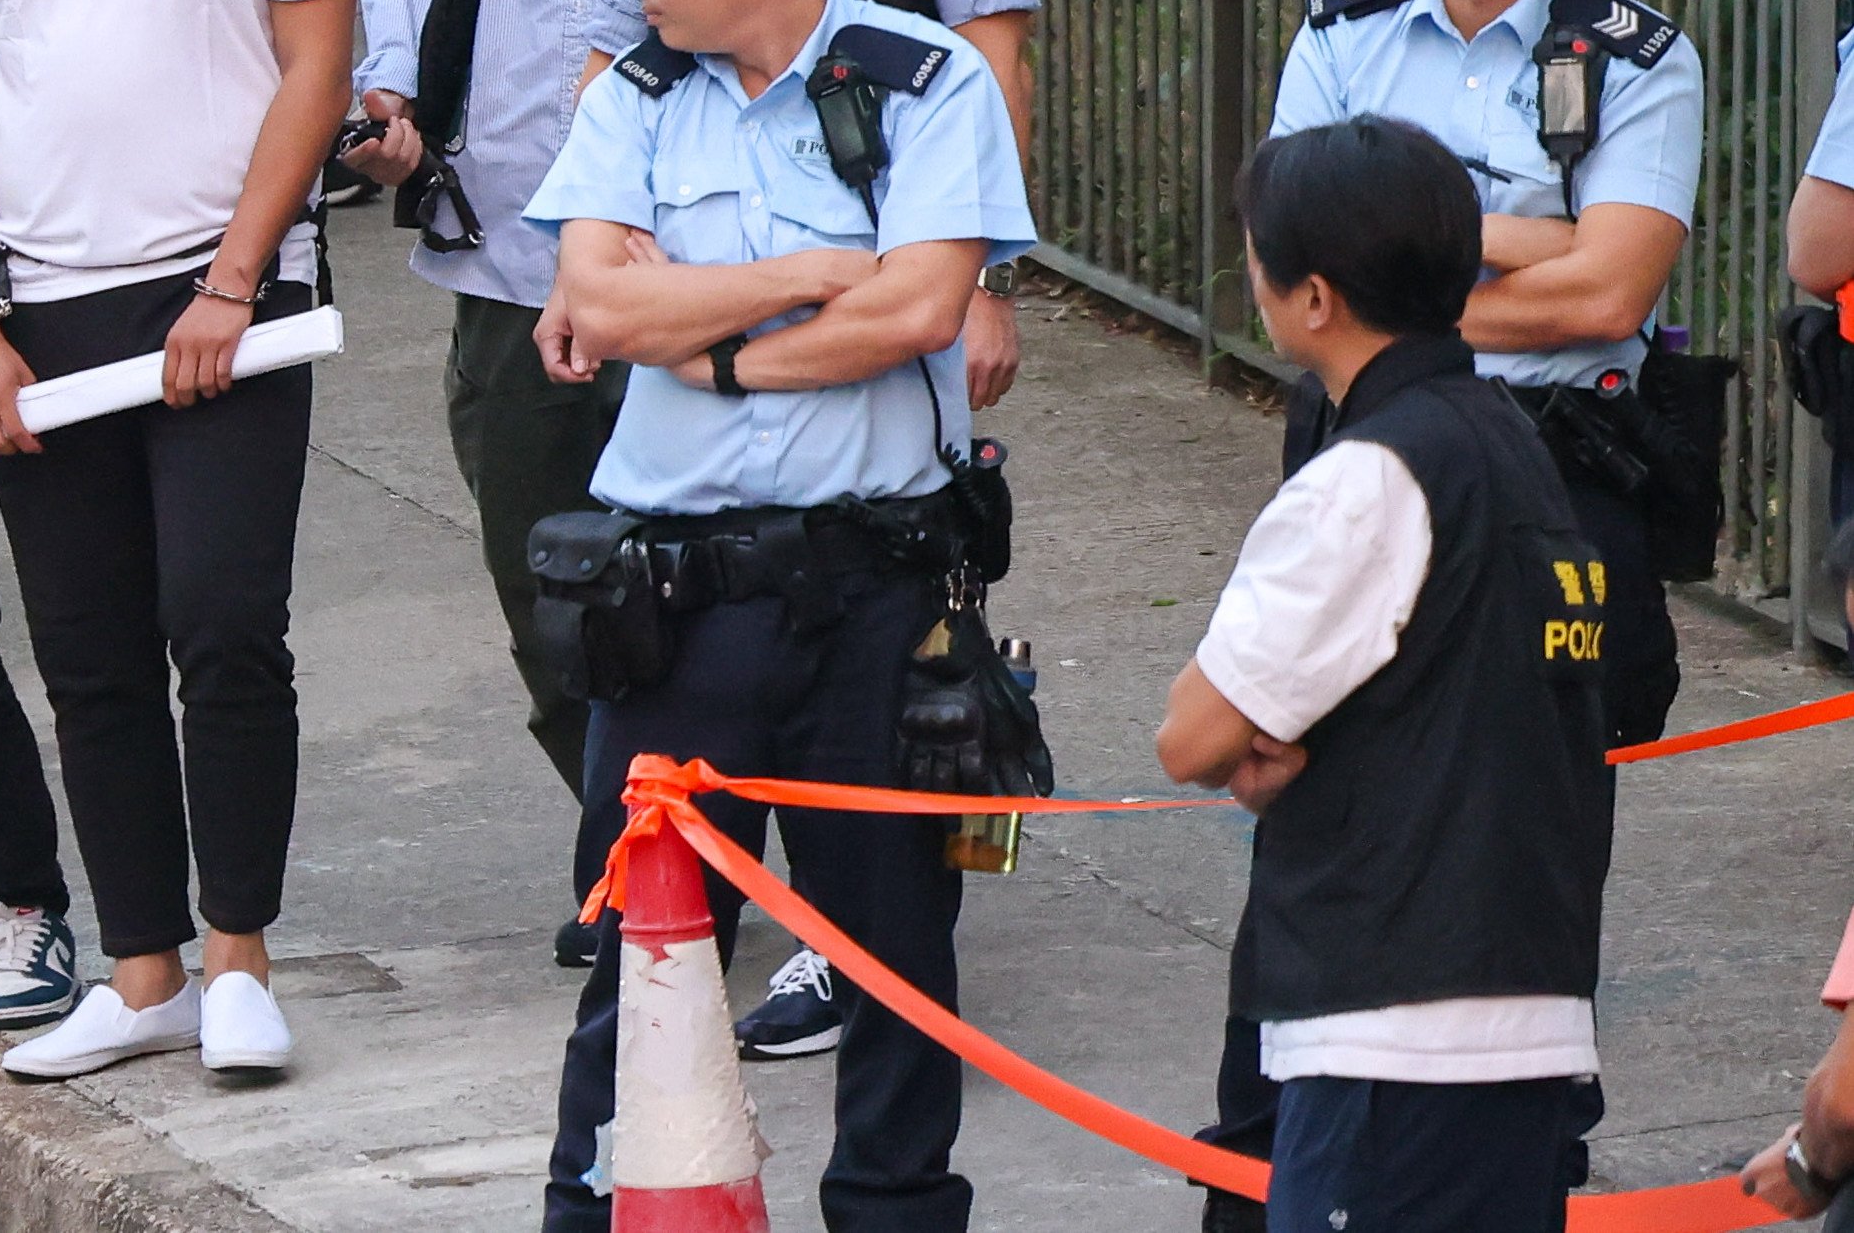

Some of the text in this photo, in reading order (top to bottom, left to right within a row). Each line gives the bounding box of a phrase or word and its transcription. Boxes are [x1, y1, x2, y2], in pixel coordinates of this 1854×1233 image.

[1638, 25, 1675, 58] 11302
[621, 60, 660, 87] 60840
[912, 50, 943, 88] 60840
